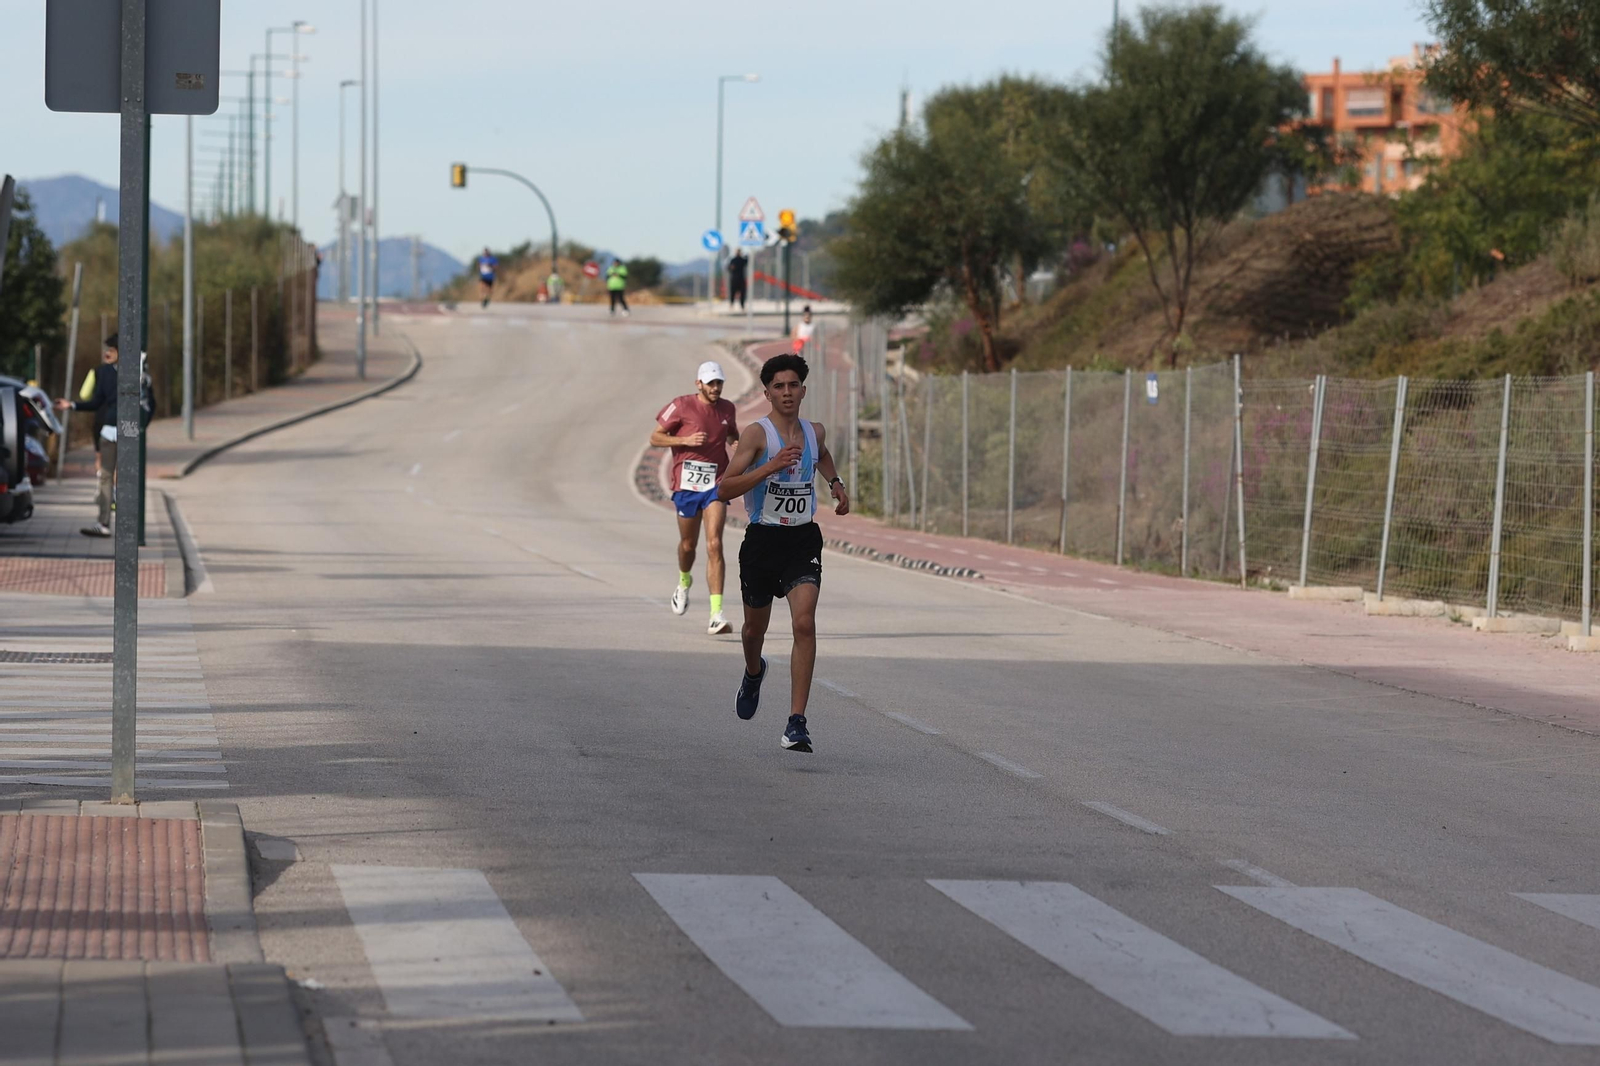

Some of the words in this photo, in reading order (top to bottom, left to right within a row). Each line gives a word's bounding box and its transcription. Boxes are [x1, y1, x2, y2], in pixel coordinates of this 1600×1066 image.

[687, 471, 711, 485] 276
[770, 487, 791, 496] UMA
[774, 496, 806, 514] 700
